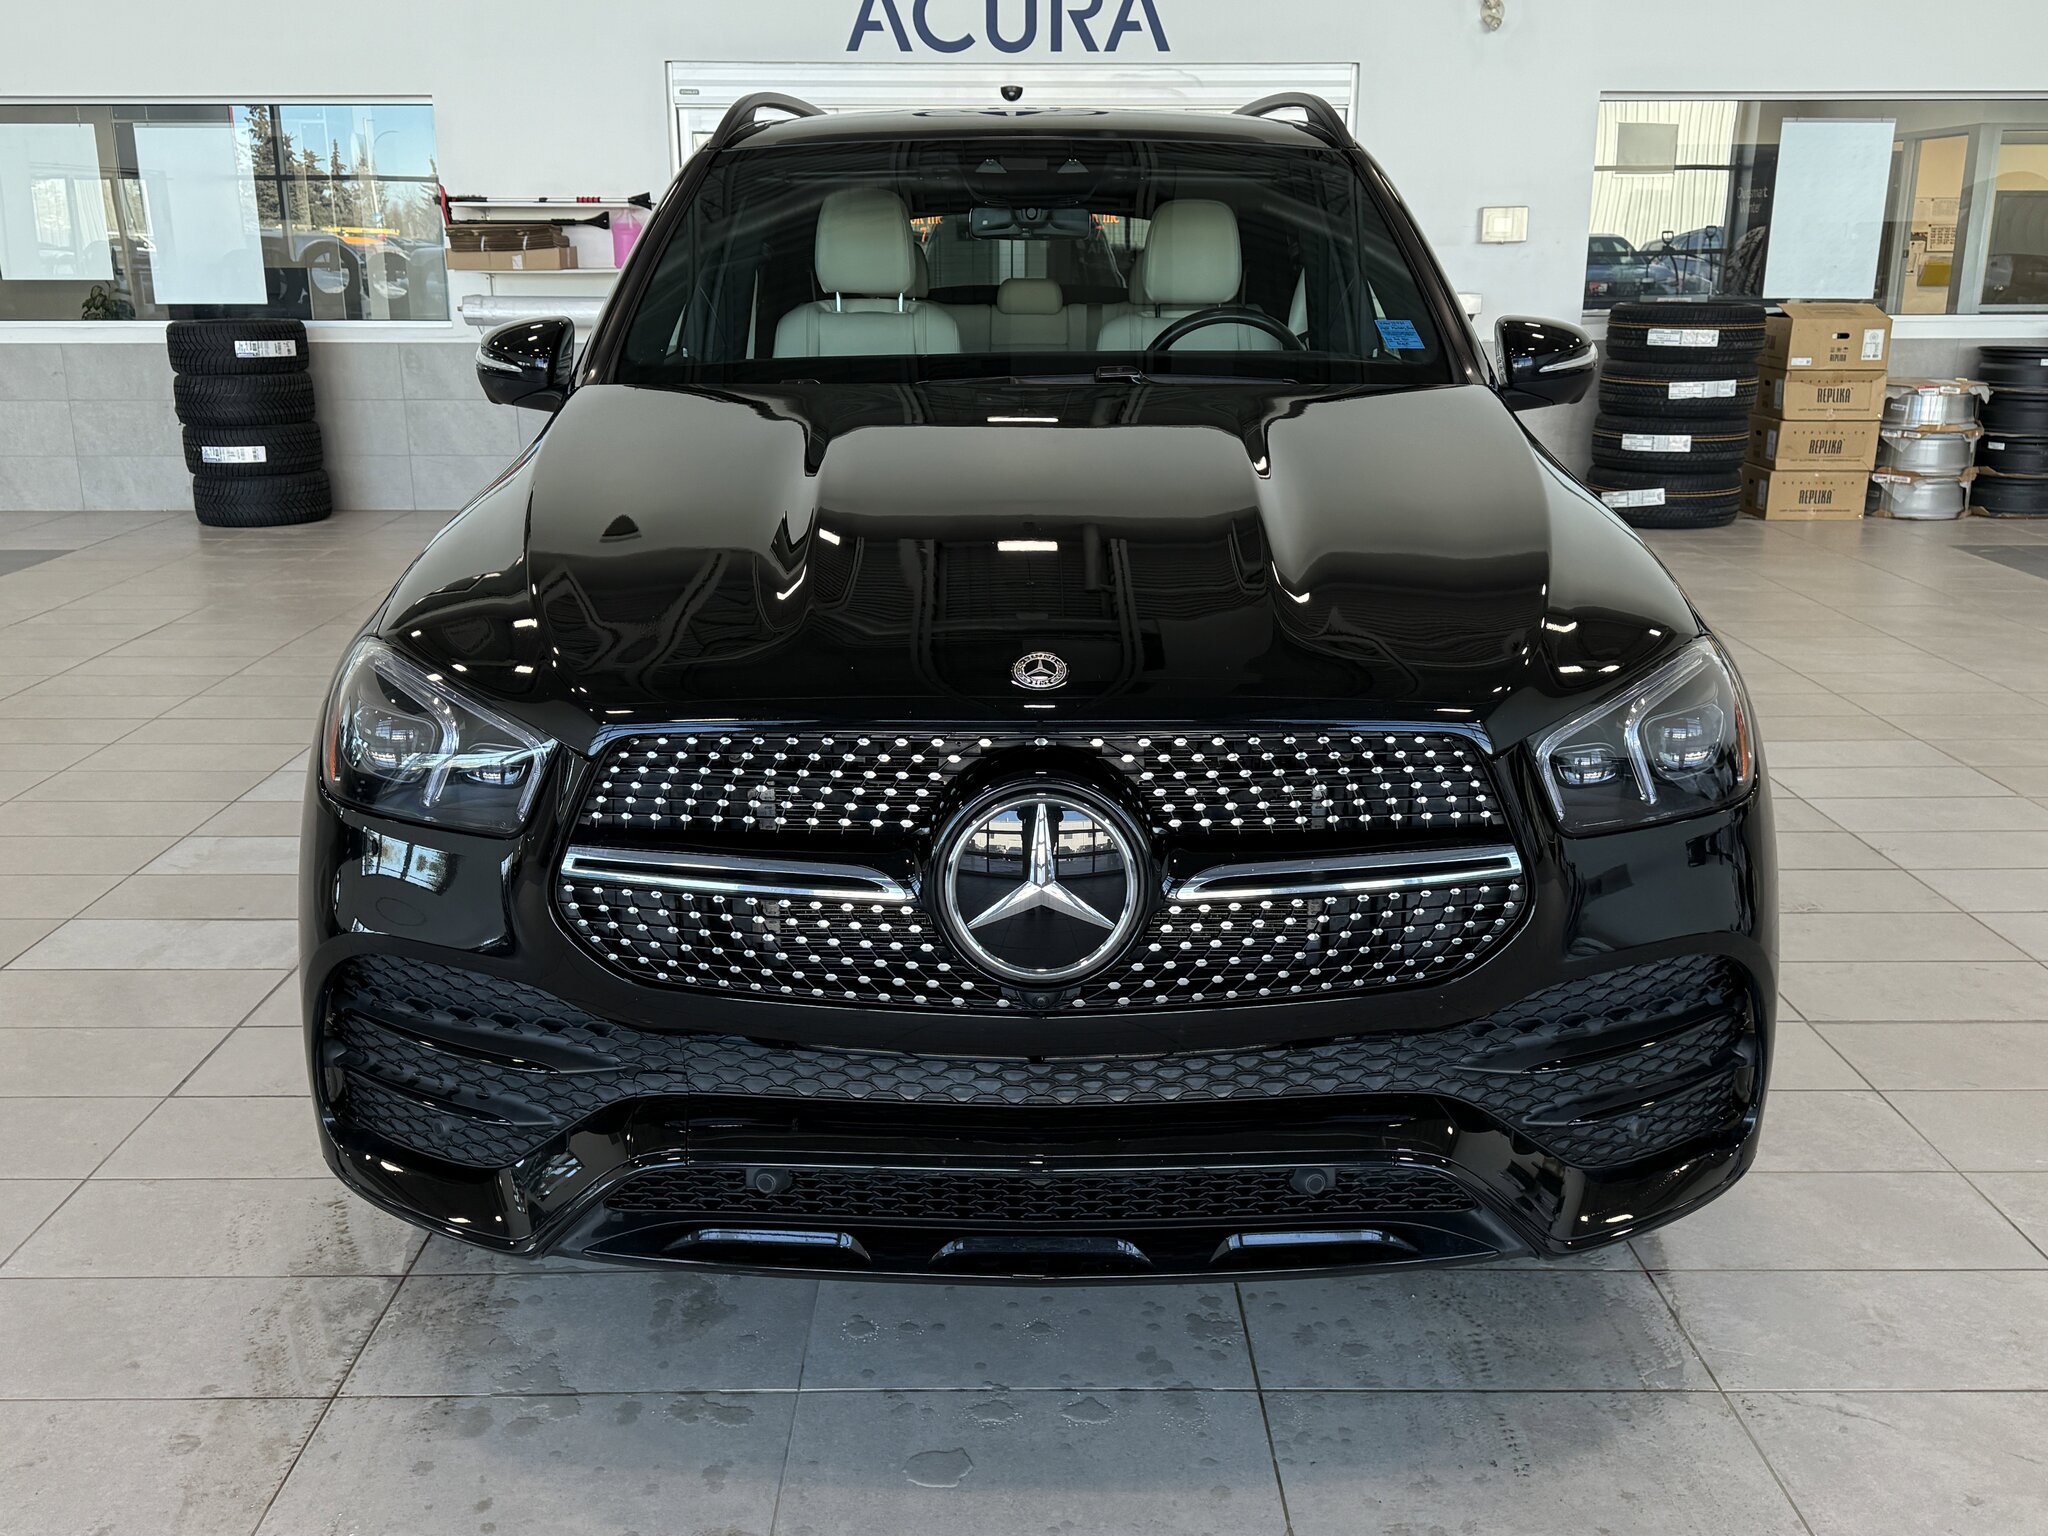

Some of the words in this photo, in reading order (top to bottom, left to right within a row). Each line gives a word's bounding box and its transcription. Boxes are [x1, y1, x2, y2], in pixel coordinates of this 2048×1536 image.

[846, 0, 1171, 53] ACURA
[1816, 388, 1852, 403] REPLIKA
[1808, 439, 1844, 454] REPLIKA
[1798, 489, 1833, 504] REPLIKA
